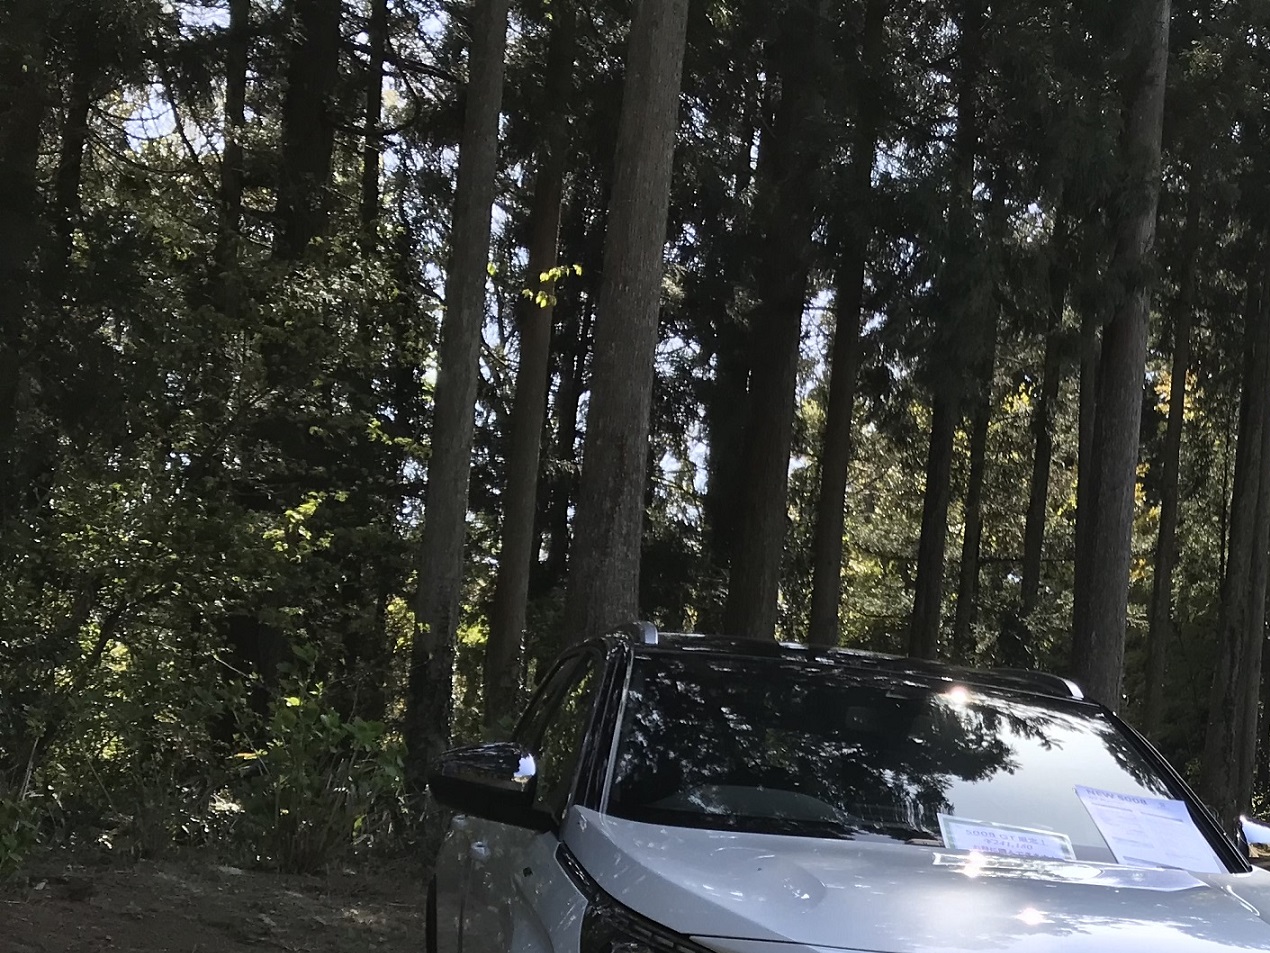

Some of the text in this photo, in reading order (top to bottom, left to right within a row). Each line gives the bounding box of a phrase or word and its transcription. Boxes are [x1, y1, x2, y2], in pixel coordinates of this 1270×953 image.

[1085, 788, 1148, 805] NEW 5008
[965, 829, 996, 838] 5008
